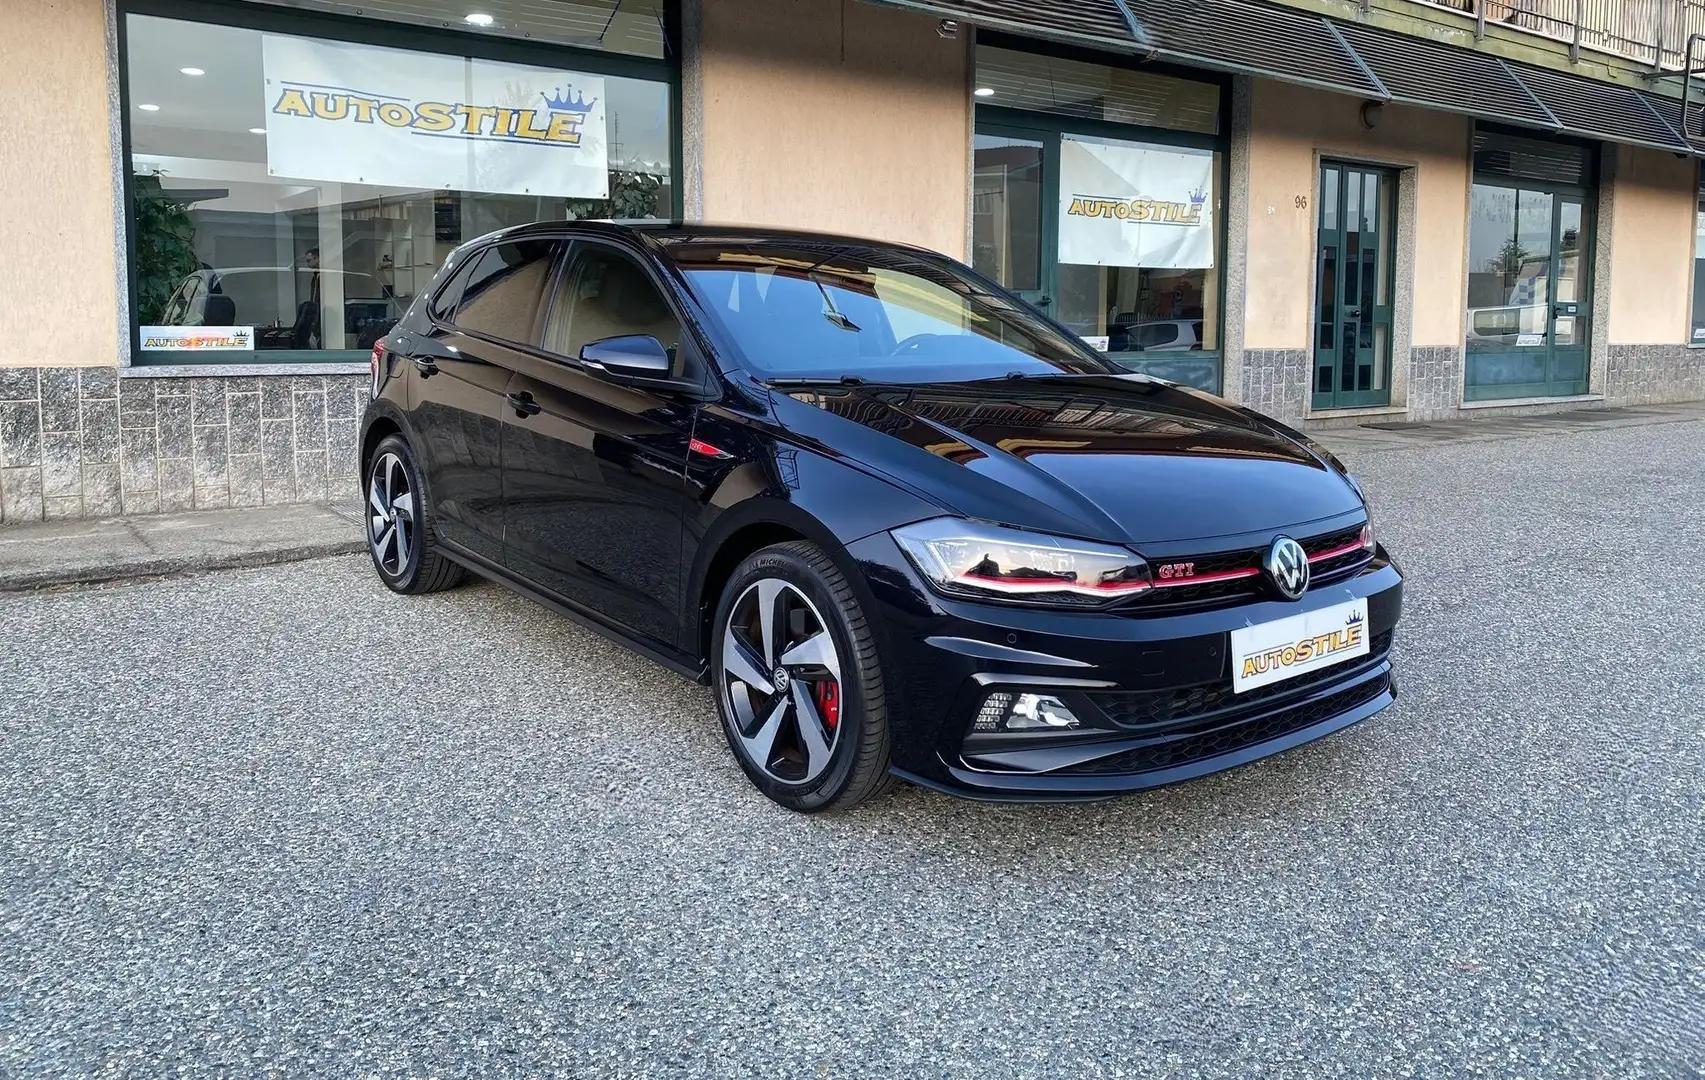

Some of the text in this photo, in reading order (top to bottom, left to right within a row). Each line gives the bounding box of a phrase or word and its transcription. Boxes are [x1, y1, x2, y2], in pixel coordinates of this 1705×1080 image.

[273, 88, 585, 144] AUTOSTILE
[1068, 198, 1202, 223] AUTOSTILE
[1295, 195, 1307, 209] 96
[1159, 562, 1194, 579] GTI
[1241, 625, 1362, 679] AUTOSTILE
